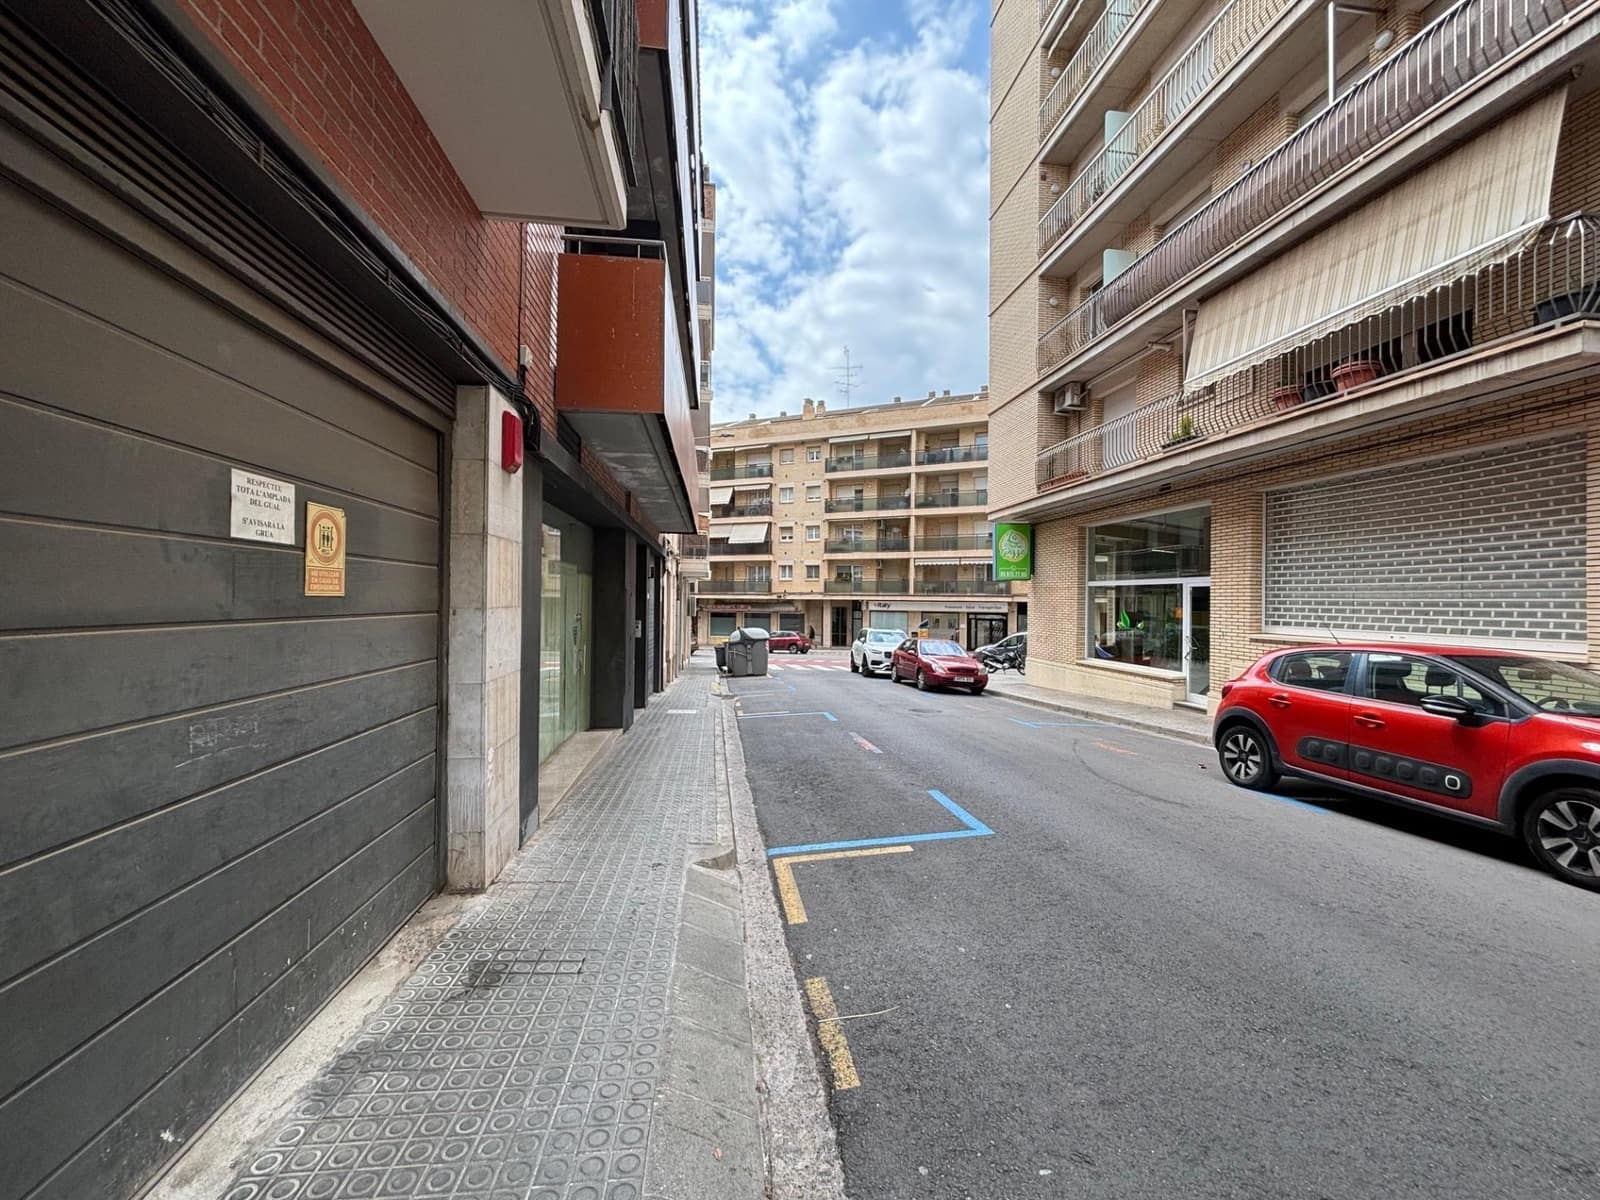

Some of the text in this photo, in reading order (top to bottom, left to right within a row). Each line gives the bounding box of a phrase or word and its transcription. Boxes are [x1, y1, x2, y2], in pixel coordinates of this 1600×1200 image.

[236, 485, 291, 504] TOTA L'AMPLADA
[249, 498, 281, 511] DEL GUAL
